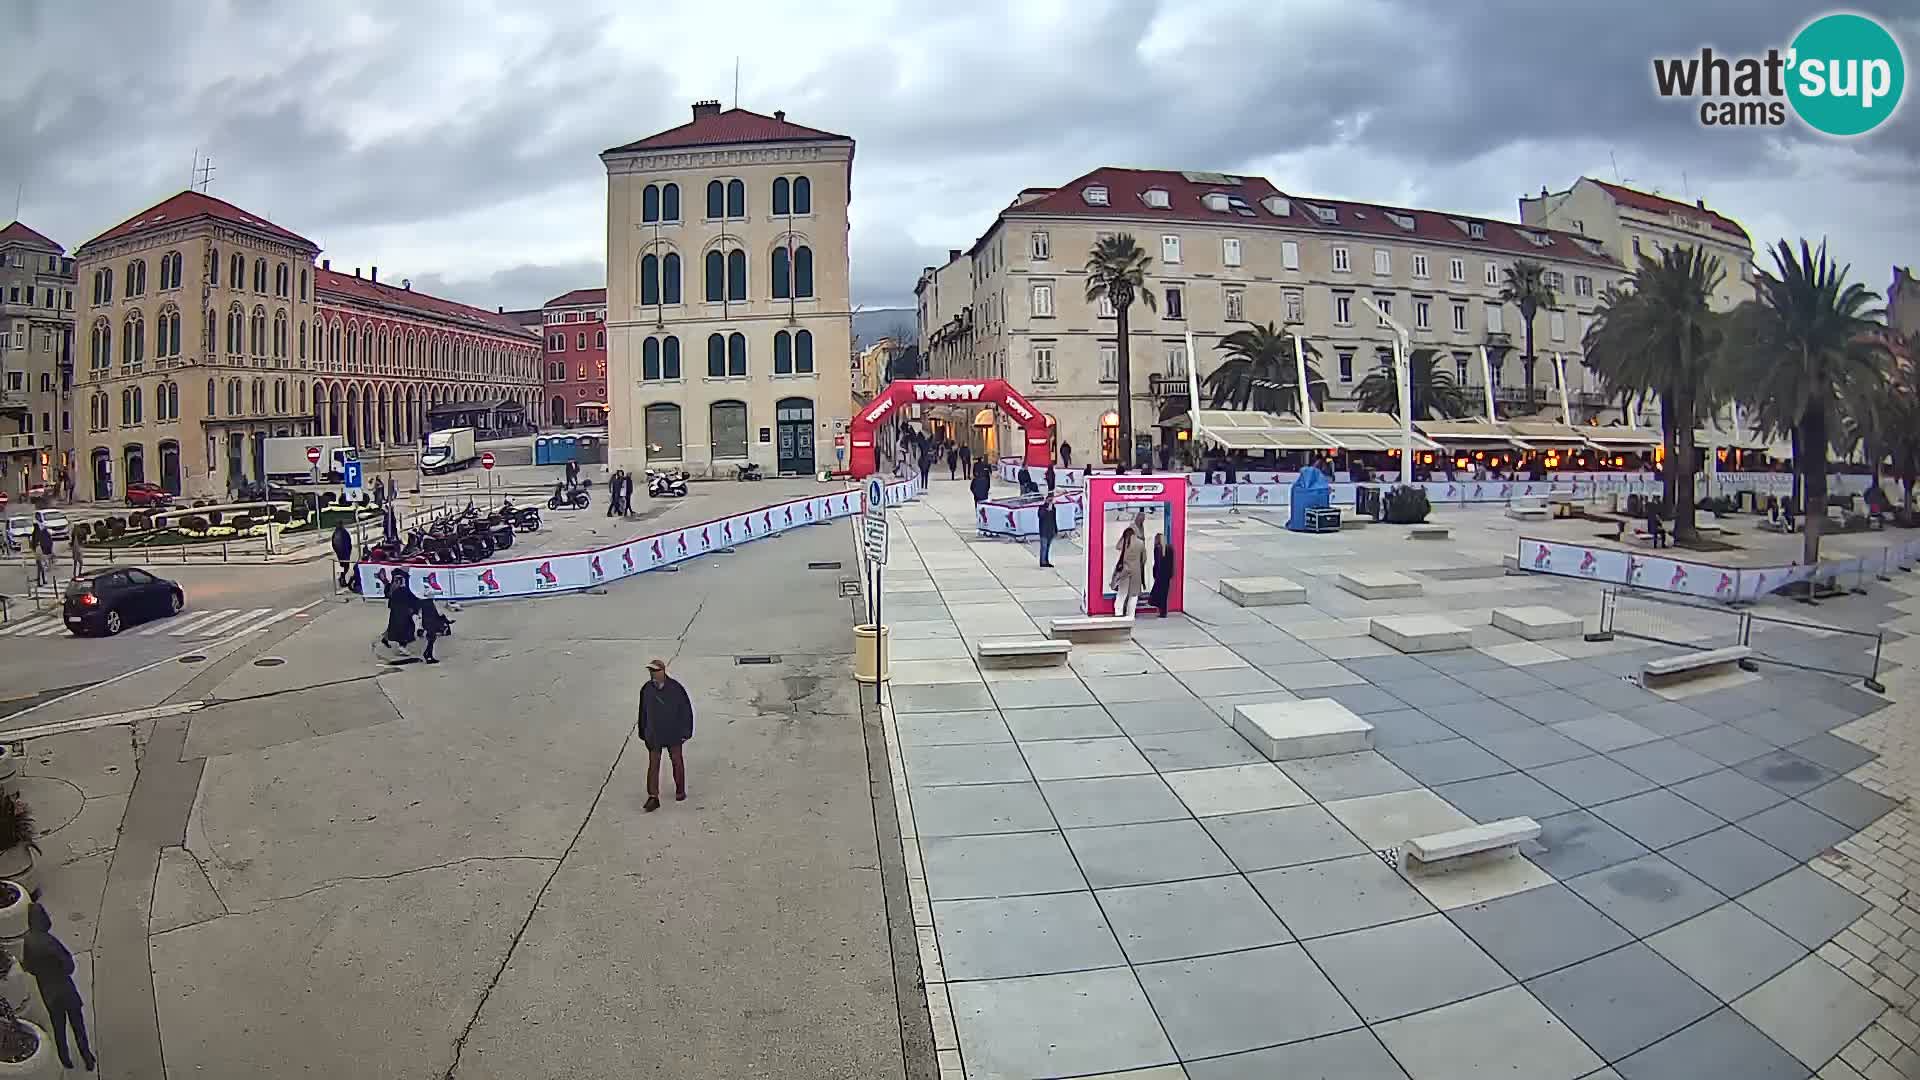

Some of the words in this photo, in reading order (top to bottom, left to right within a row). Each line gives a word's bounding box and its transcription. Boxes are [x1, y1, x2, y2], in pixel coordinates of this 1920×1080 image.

[912, 384, 985, 400] TOMMY
[865, 397, 893, 423] TOMMY
[1005, 395, 1034, 420] TOMMY
[349, 467, 357, 483] P
